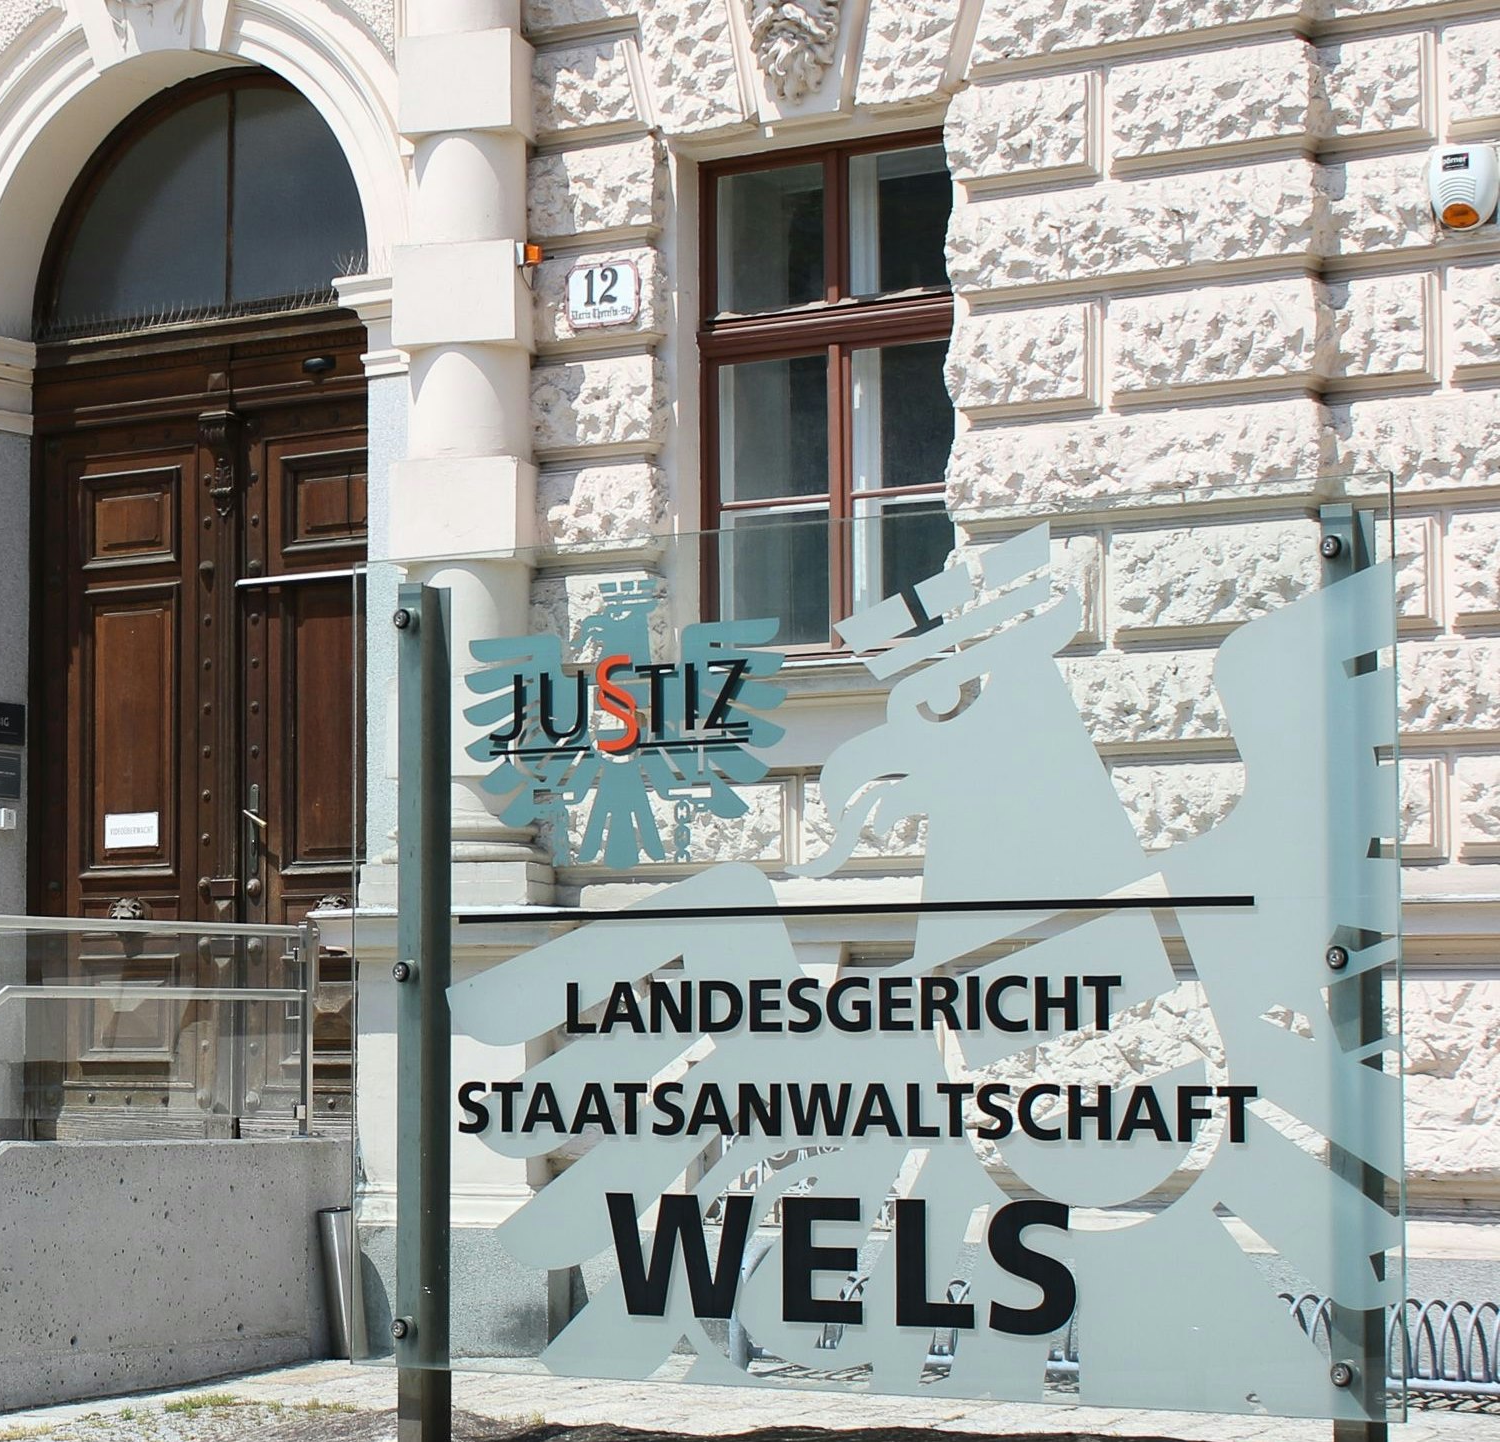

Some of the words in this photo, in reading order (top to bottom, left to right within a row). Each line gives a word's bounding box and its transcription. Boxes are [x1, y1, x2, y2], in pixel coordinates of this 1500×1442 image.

[584, 267, 619, 306] 12
[566, 975, 1122, 1034] LANDESGERICHT
[457, 1081, 1258, 1143] STAATSANWALTSCHAFT
[605, 1192, 1077, 1336] WELS
